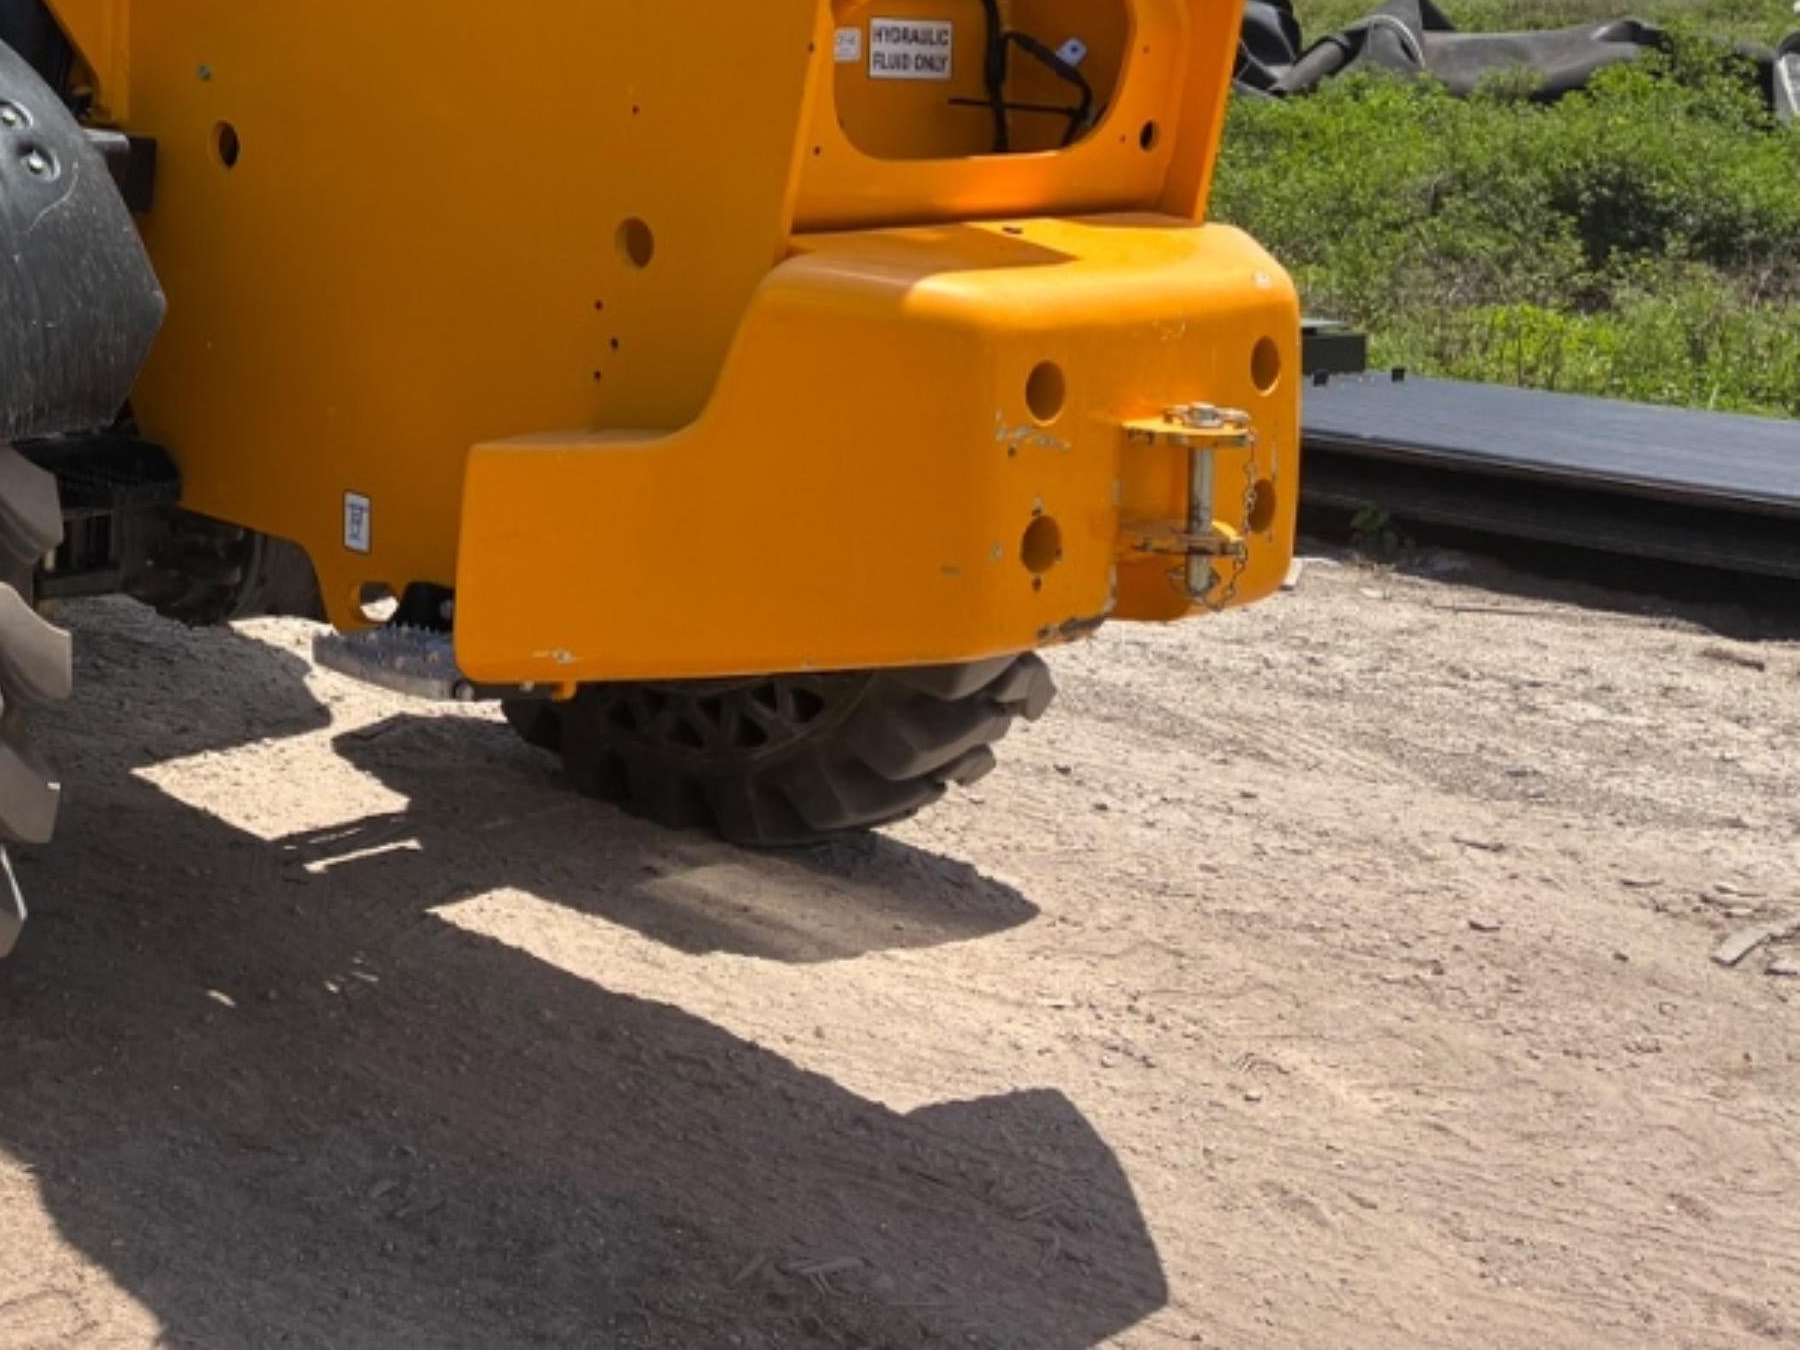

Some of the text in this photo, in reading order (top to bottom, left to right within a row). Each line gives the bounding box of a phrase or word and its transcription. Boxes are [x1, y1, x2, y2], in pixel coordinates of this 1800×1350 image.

[872, 25, 949, 46] HYDRAULIC
[873, 52, 948, 73] FLUID ONLY
